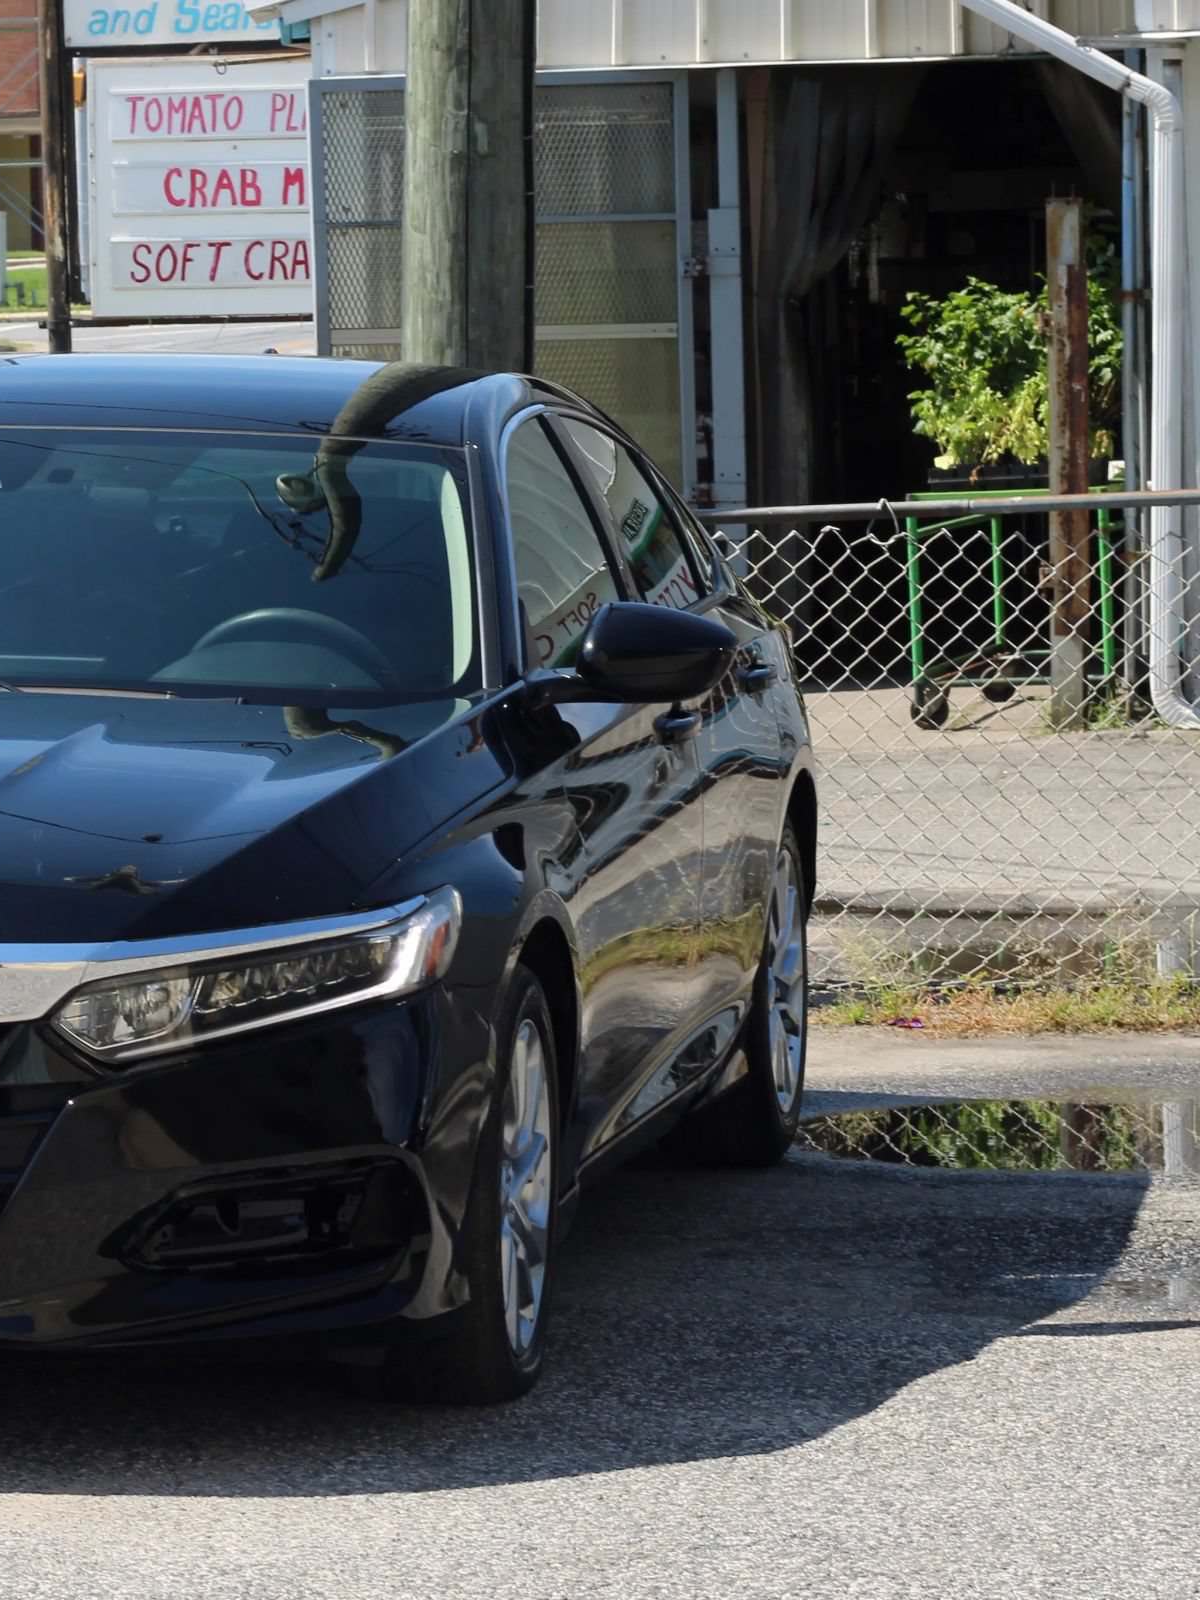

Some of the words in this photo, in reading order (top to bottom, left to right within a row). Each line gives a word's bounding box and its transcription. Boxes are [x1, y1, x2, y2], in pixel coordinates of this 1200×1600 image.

[87, 0, 157, 35] and
[125, 93, 244, 135] TOMATO
[270, 93, 307, 132] PL
[163, 167, 262, 208] CRAB
[130, 241, 232, 283] SOFT
